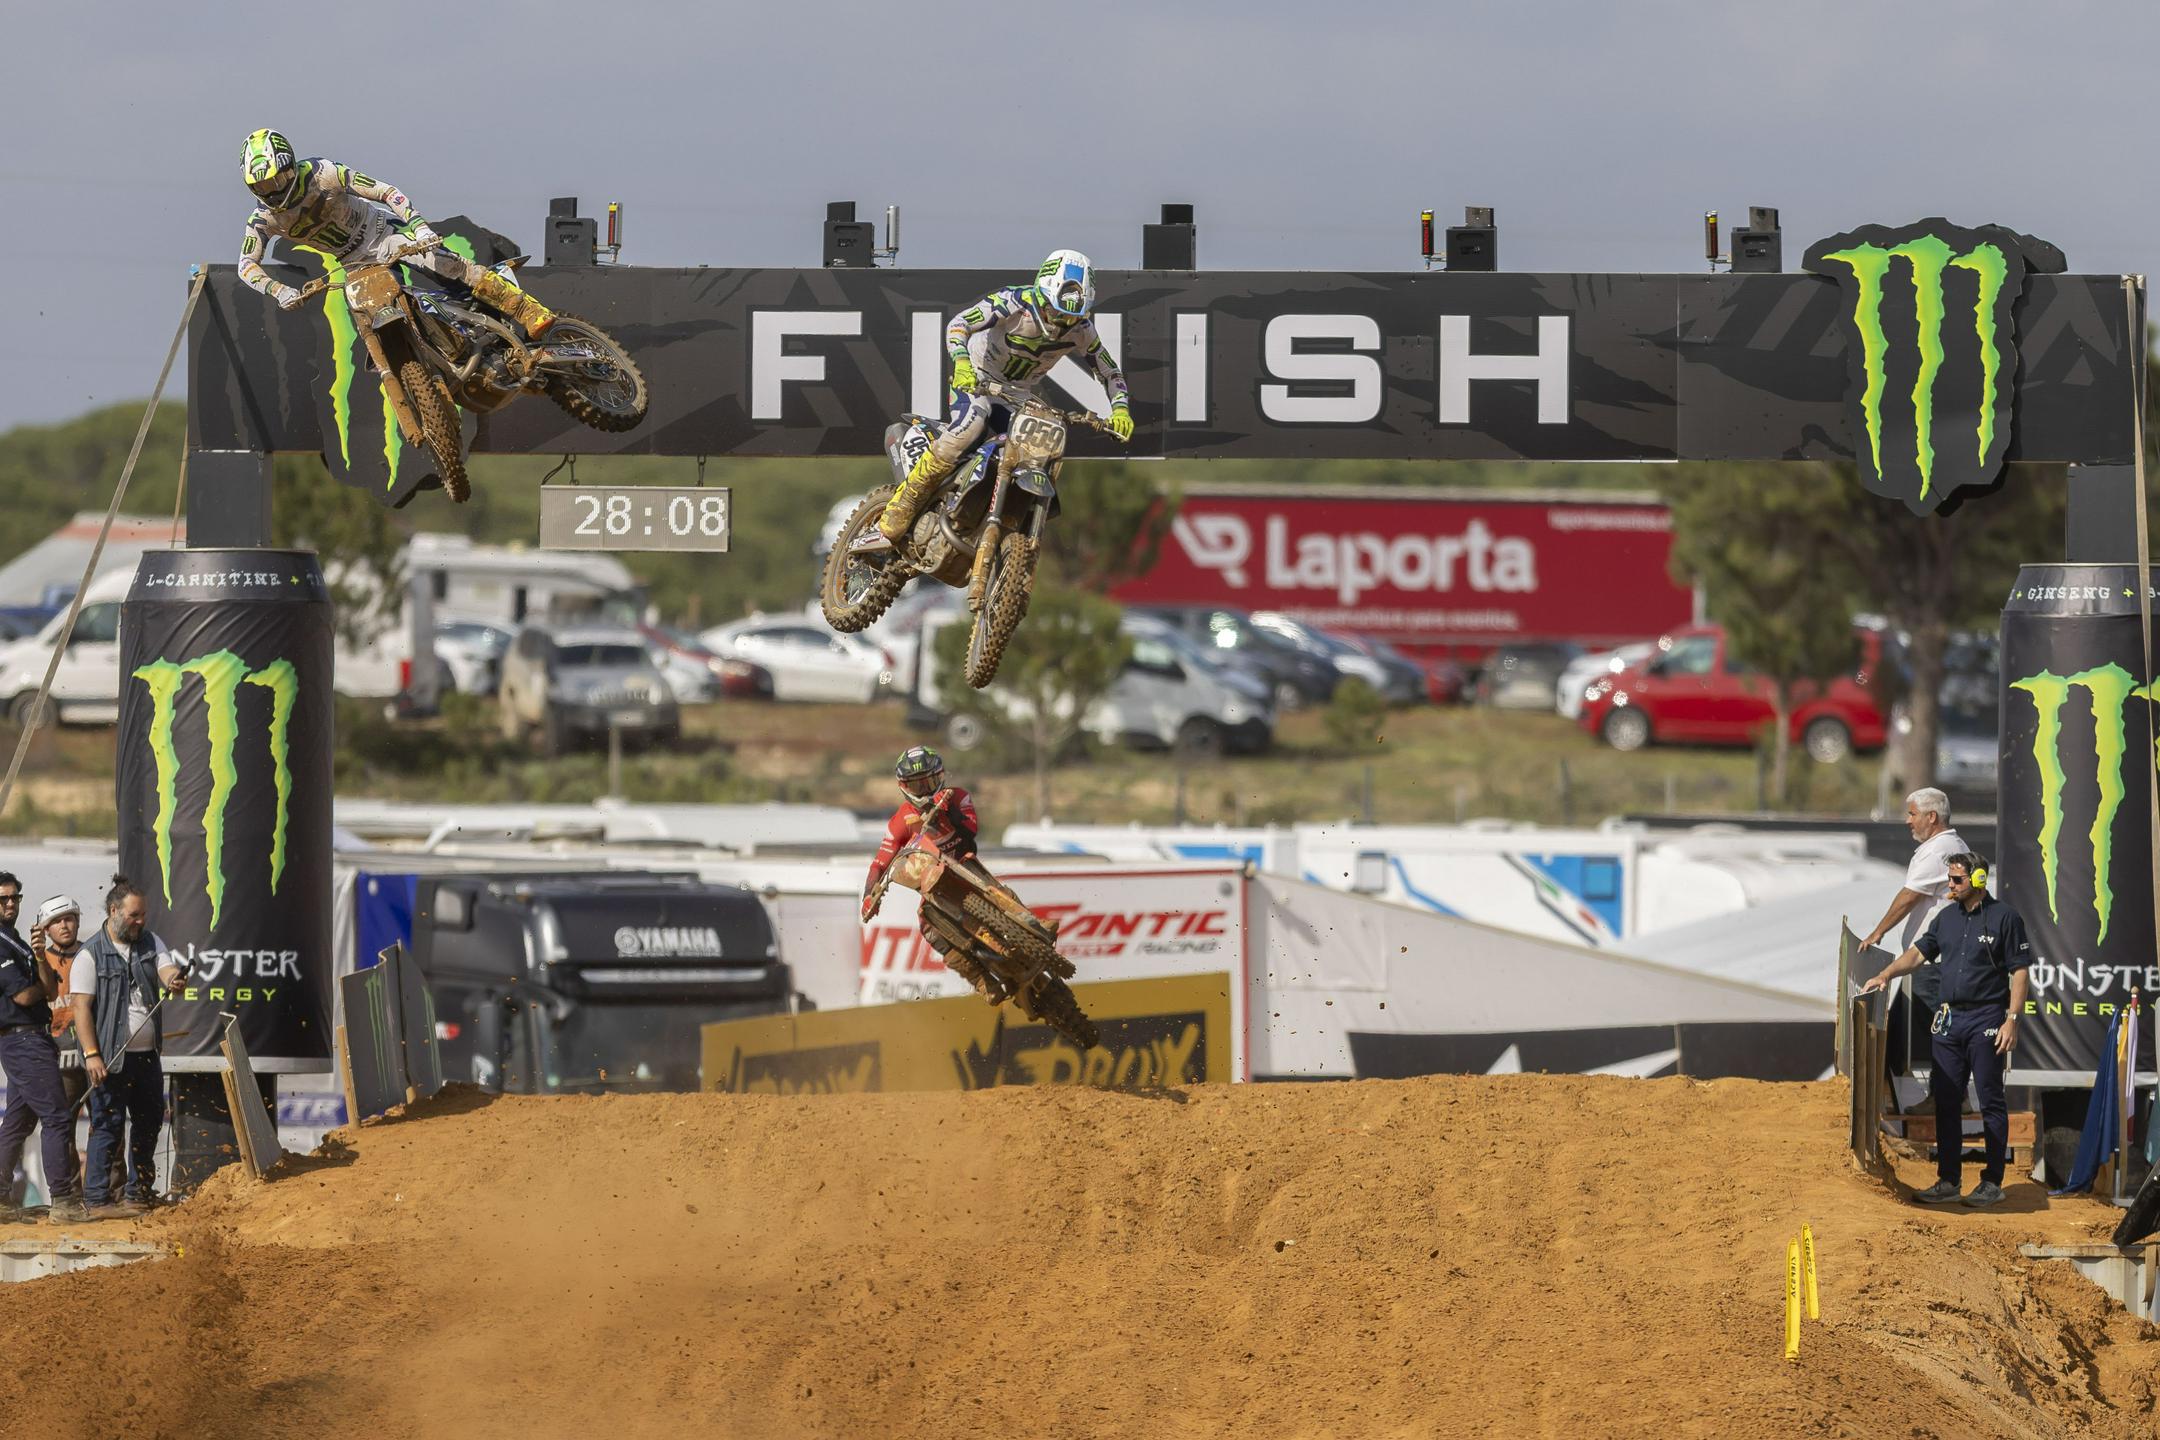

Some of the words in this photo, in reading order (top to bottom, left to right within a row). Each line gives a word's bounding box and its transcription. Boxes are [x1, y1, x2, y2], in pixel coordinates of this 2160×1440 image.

[1016, 418, 1064, 452] 959
[574, 495, 726, 536] 28:08
[1265, 515, 1538, 604] Laporta
[146, 571, 281, 588] L-CARNITINE
[2028, 586, 2111, 602] GINSENG
[637, 927, 721, 951] YAMAHA
[861, 926, 945, 970] NTIC
[169, 942, 302, 982] NSTER
[2029, 957, 2160, 996] ONSTE
[159, 988, 276, 1002] NERGY
[2024, 1001, 2155, 1015] ENER
